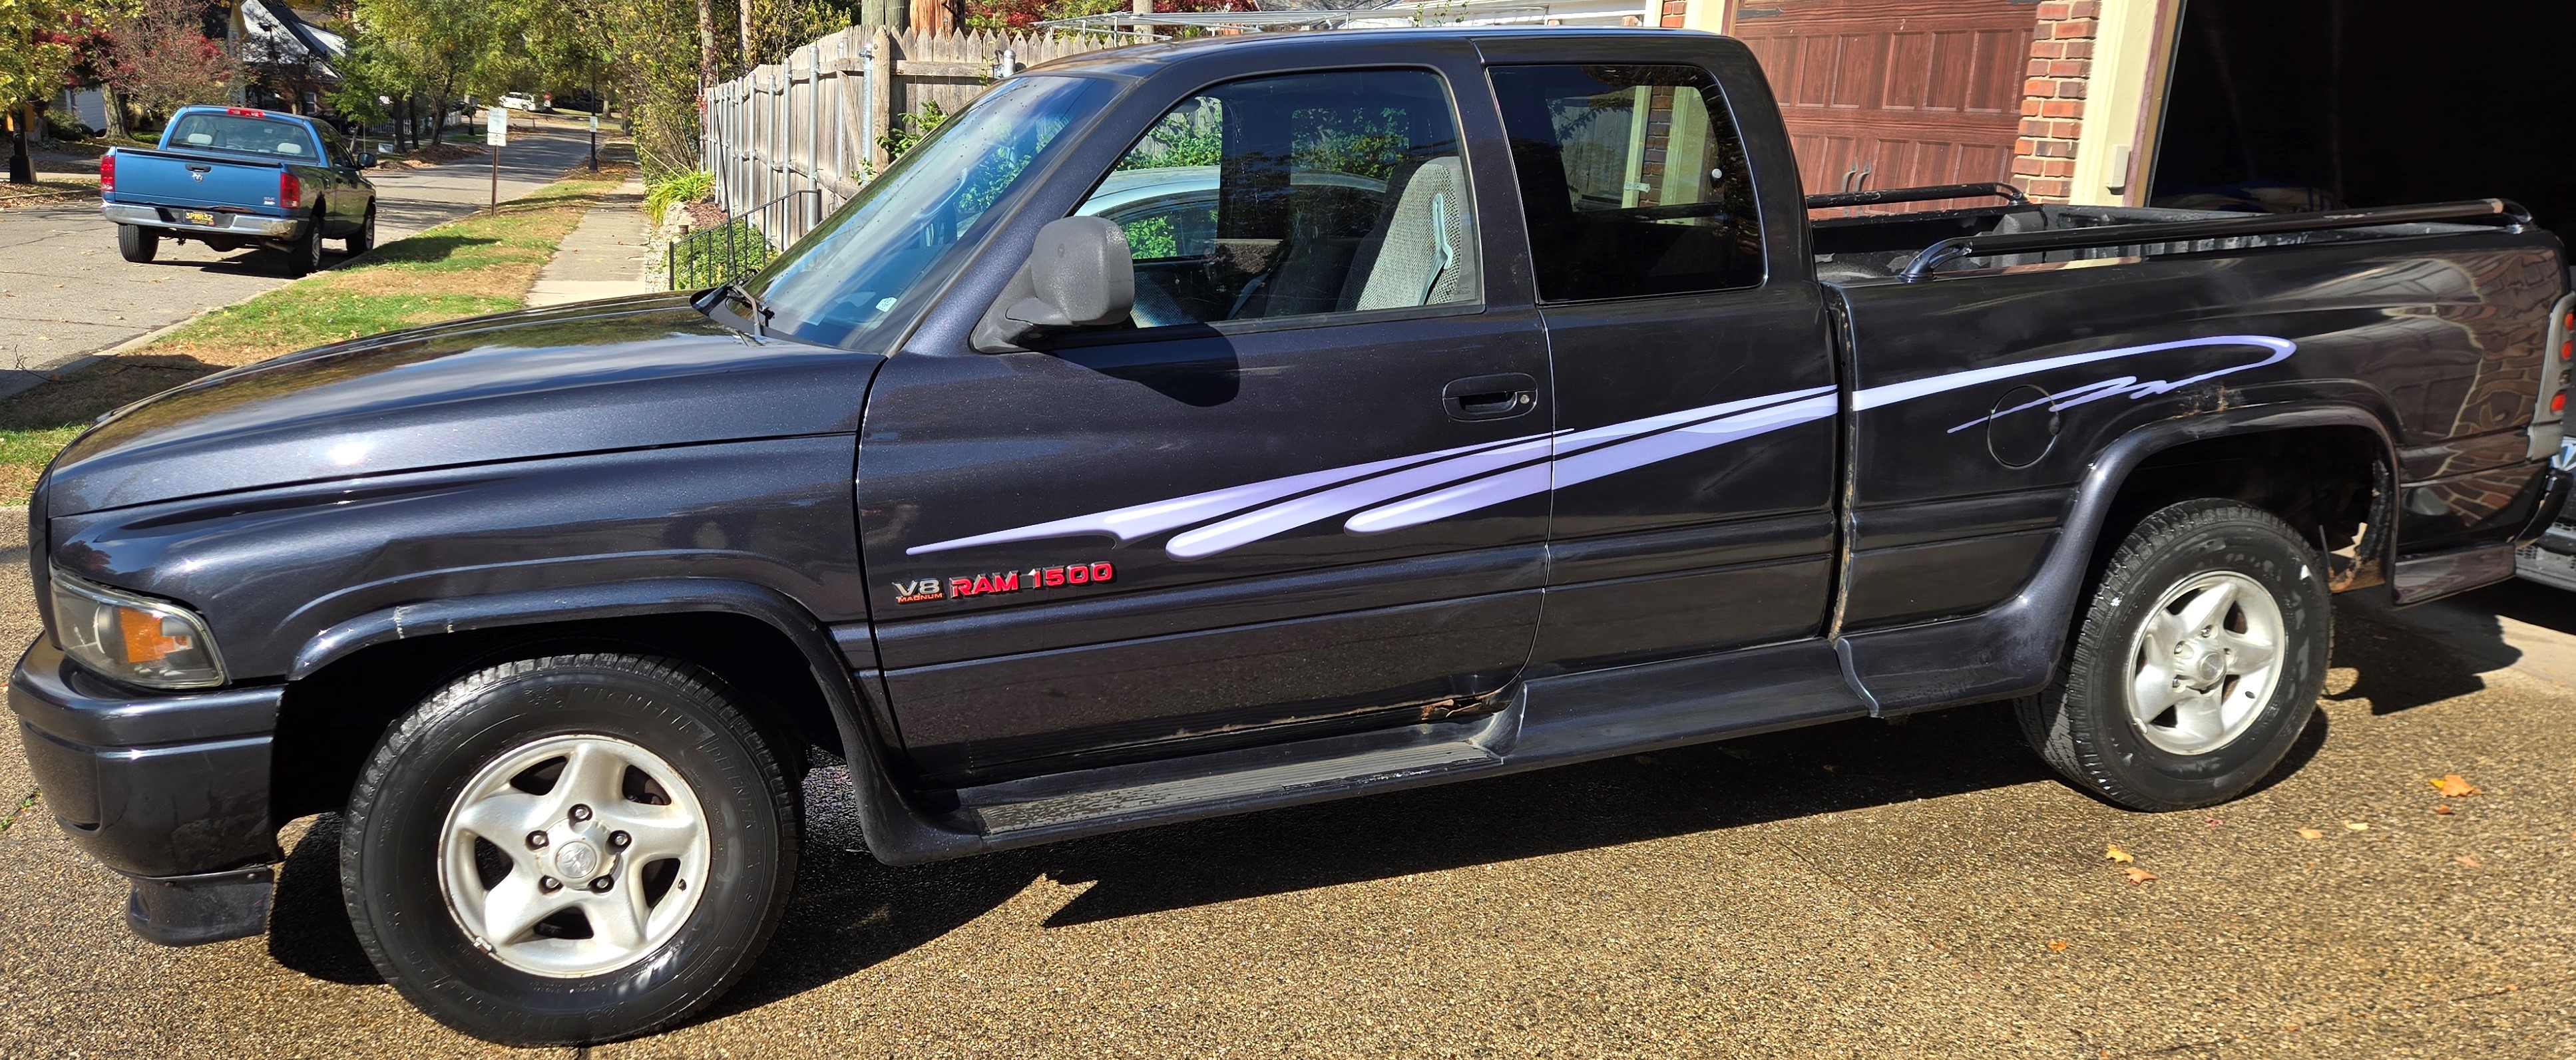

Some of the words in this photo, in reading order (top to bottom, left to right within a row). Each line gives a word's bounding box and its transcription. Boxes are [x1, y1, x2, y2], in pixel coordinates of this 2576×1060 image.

[892, 579, 941, 596] V8
[949, 571, 1019, 598] RAM
[1029, 561, 1114, 588] 1500
[896, 592, 943, 603] MAGNUM
